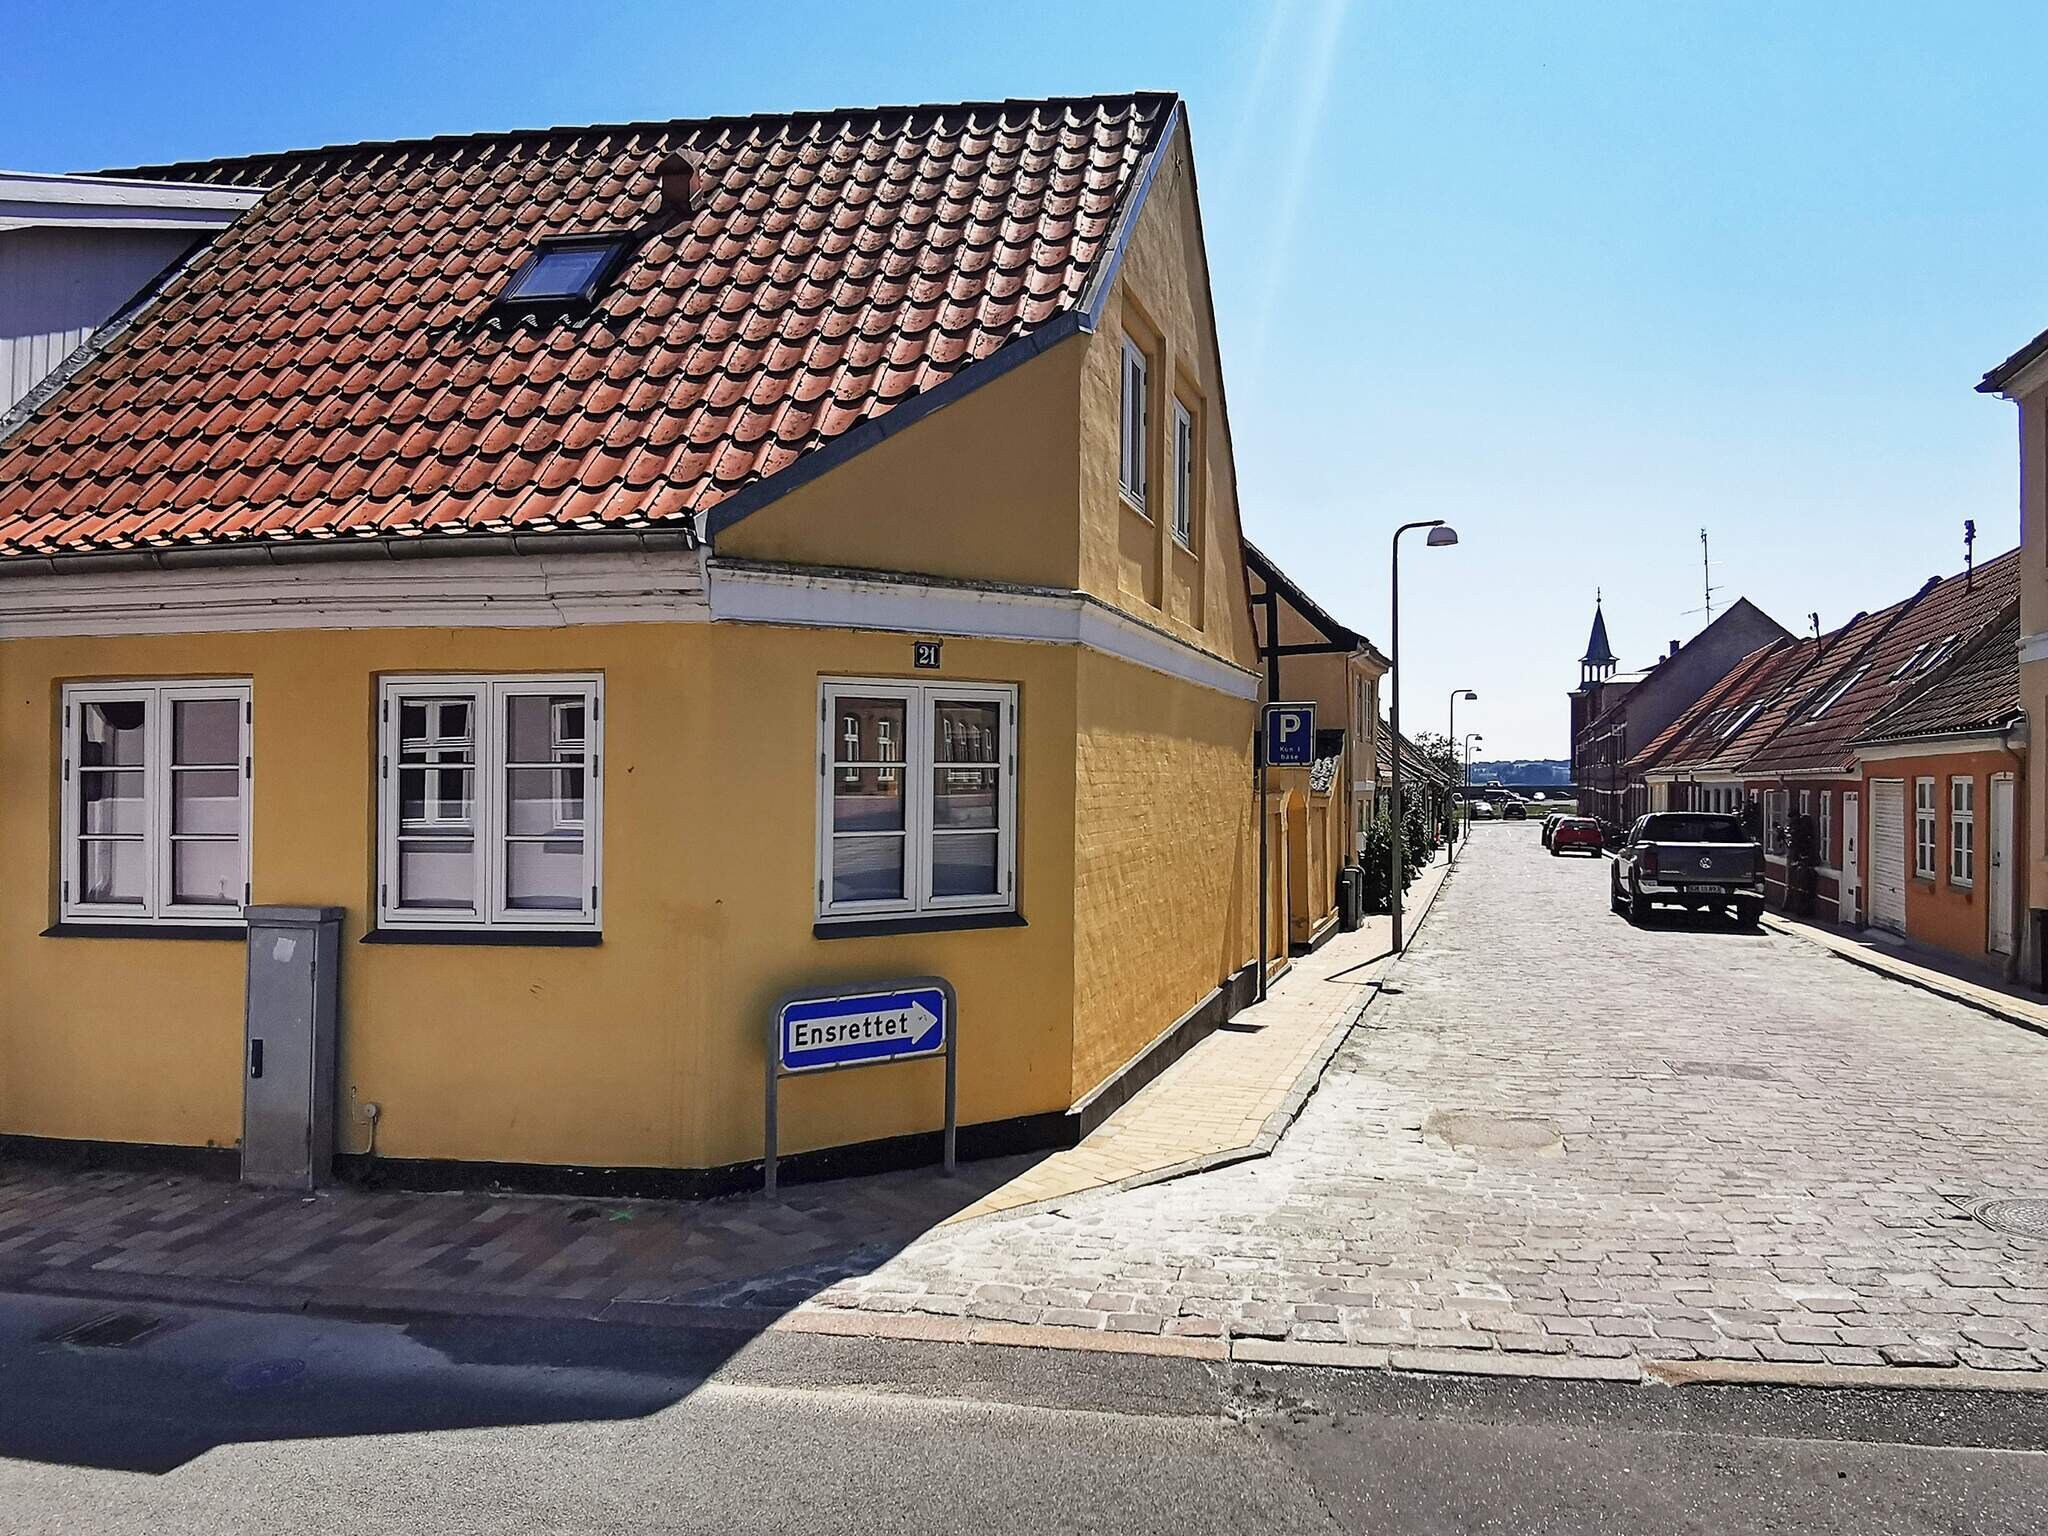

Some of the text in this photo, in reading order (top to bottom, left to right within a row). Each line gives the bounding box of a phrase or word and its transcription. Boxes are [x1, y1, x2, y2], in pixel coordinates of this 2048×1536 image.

[919, 646, 935, 665] 21
[1279, 714, 1301, 743] P
[795, 1012, 908, 1047] Ensrettet
